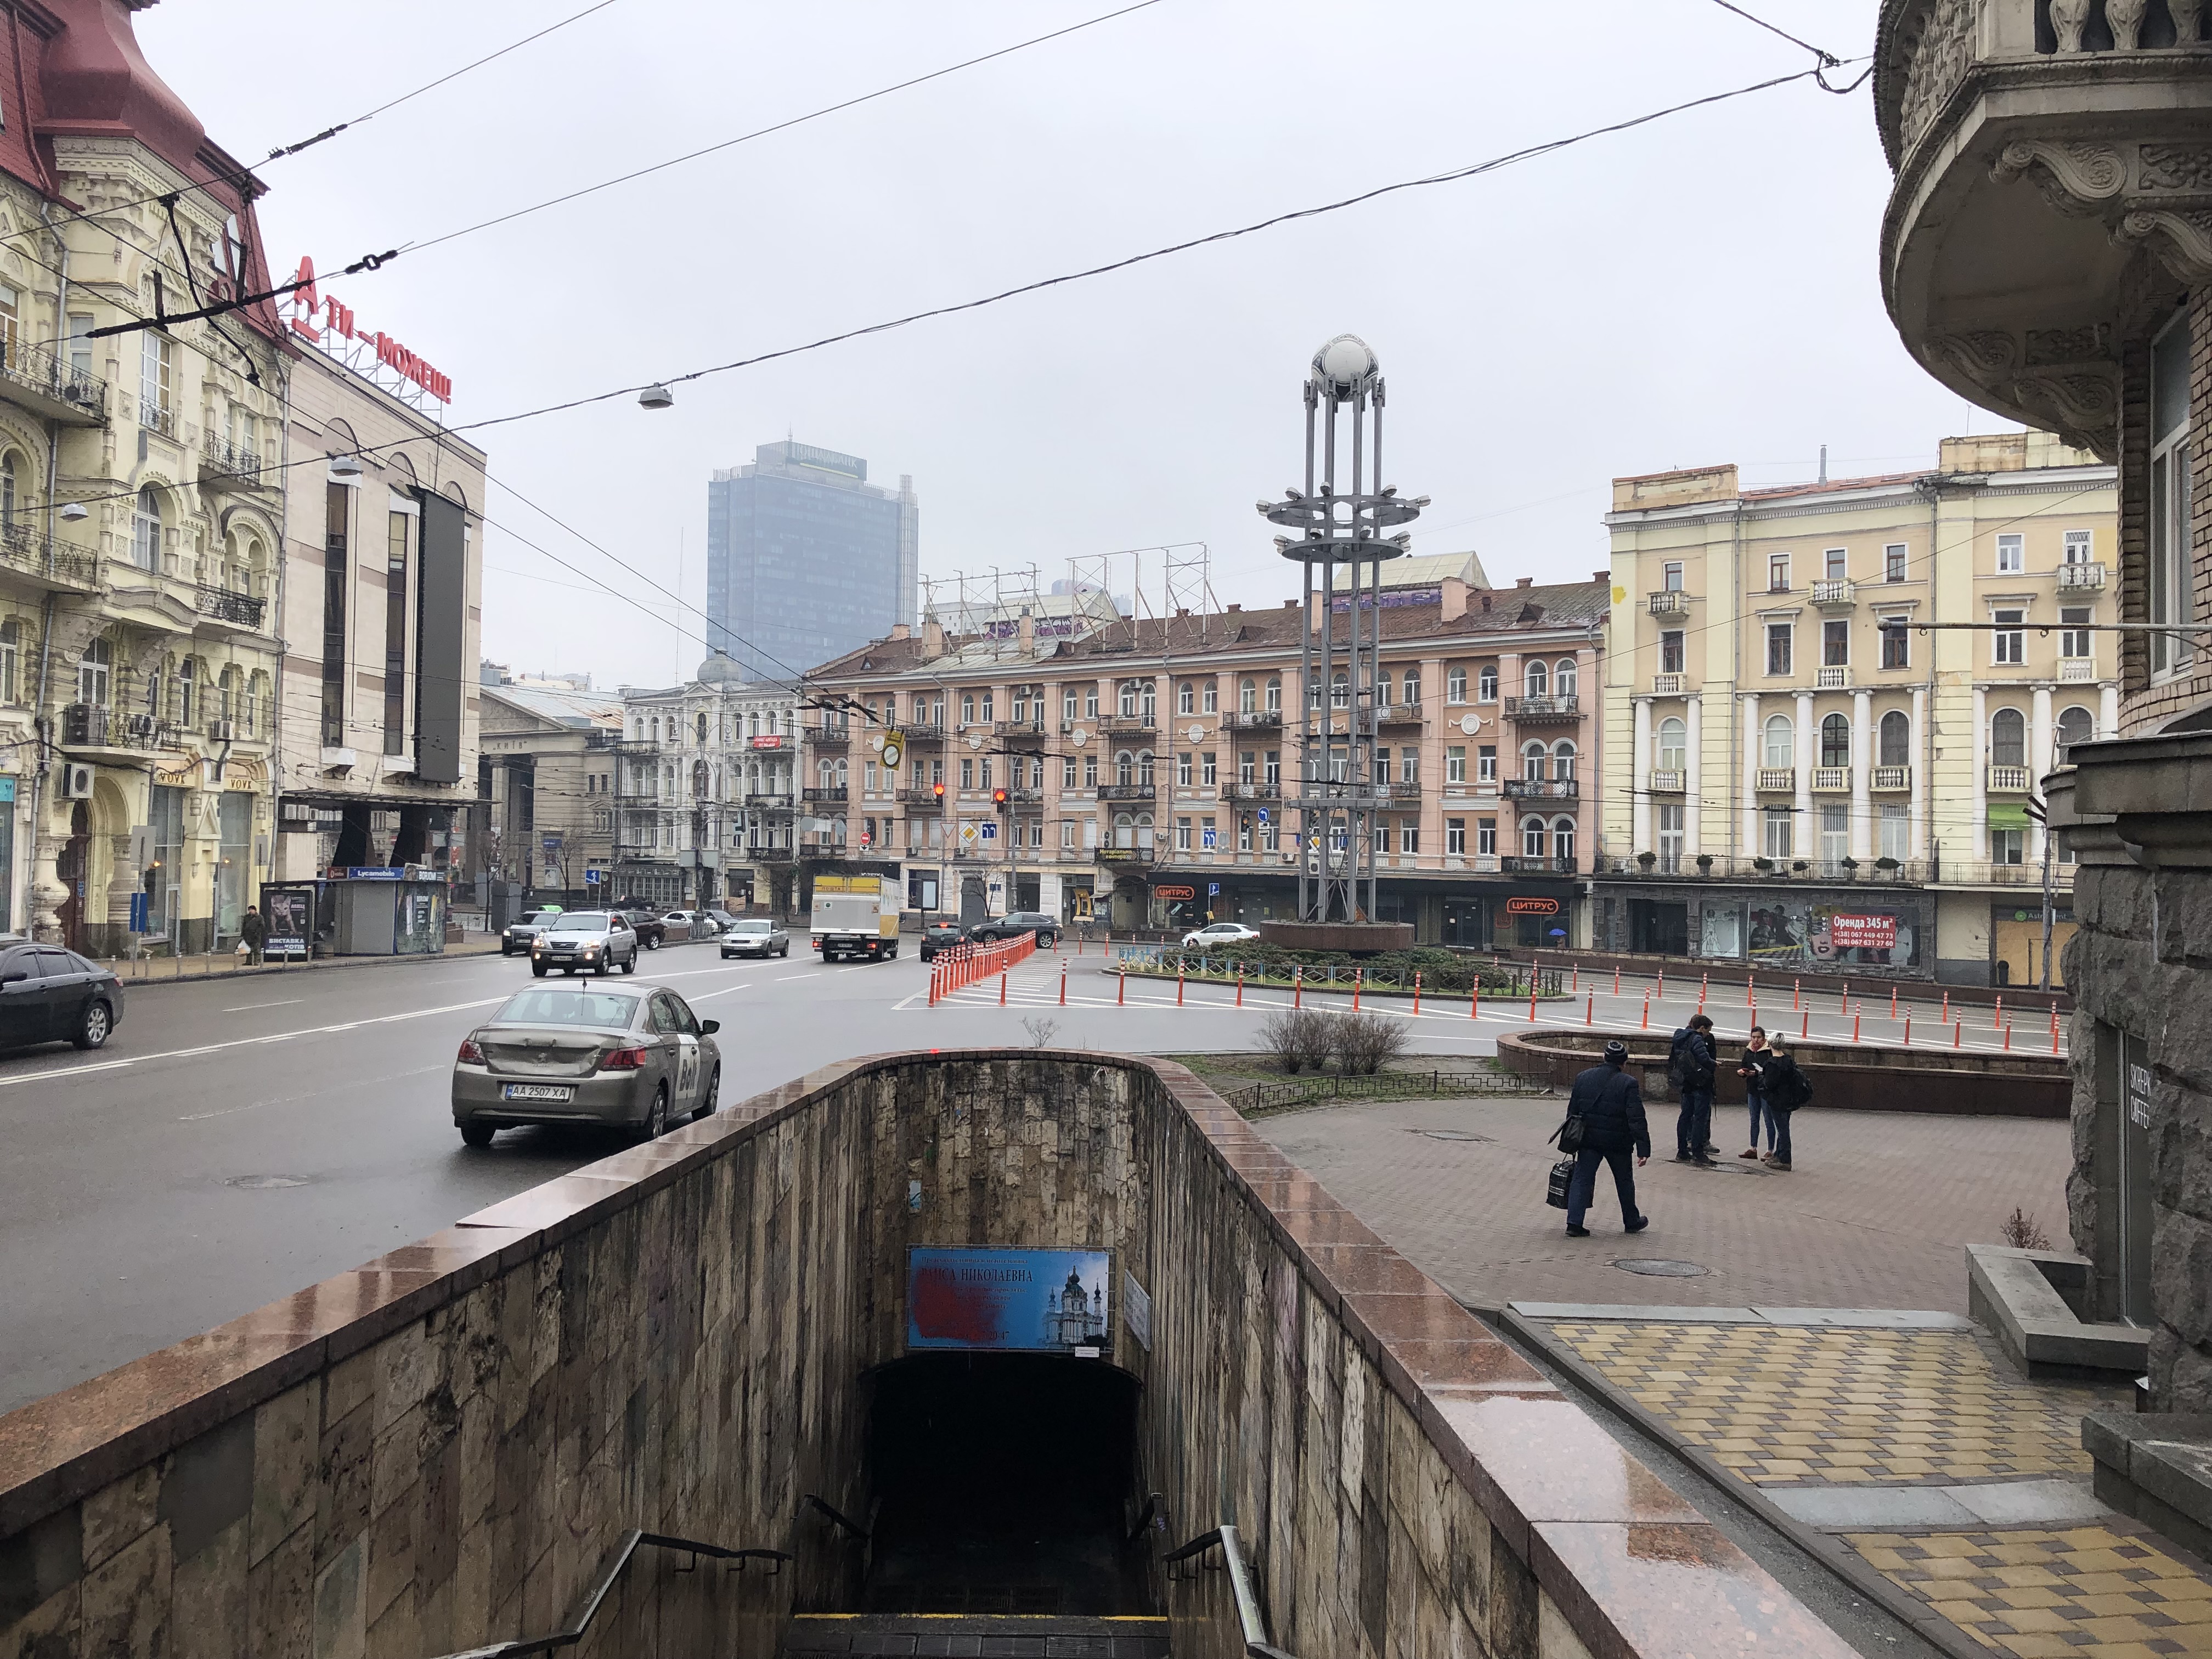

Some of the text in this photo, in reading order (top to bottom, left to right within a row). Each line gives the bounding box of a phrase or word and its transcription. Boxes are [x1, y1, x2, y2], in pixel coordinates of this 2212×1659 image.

[326, 295, 353, 340] ТИ
[377, 331, 452, 404] МОЖЕШ!
[160, 772, 184, 784] VOVK
[231, 779, 251, 789] VOVK
[1159, 889, 1190, 897] ЦИТРУС
[1512, 901, 1554, 911] ЦИТРУС
[1833, 916, 1865, 930] Оренда
[1866, 917, 1881, 928] 345
[528, 1087, 550, 1096] 2507
[961, 1268, 1032, 1282] НИКОЛАЕВНА
